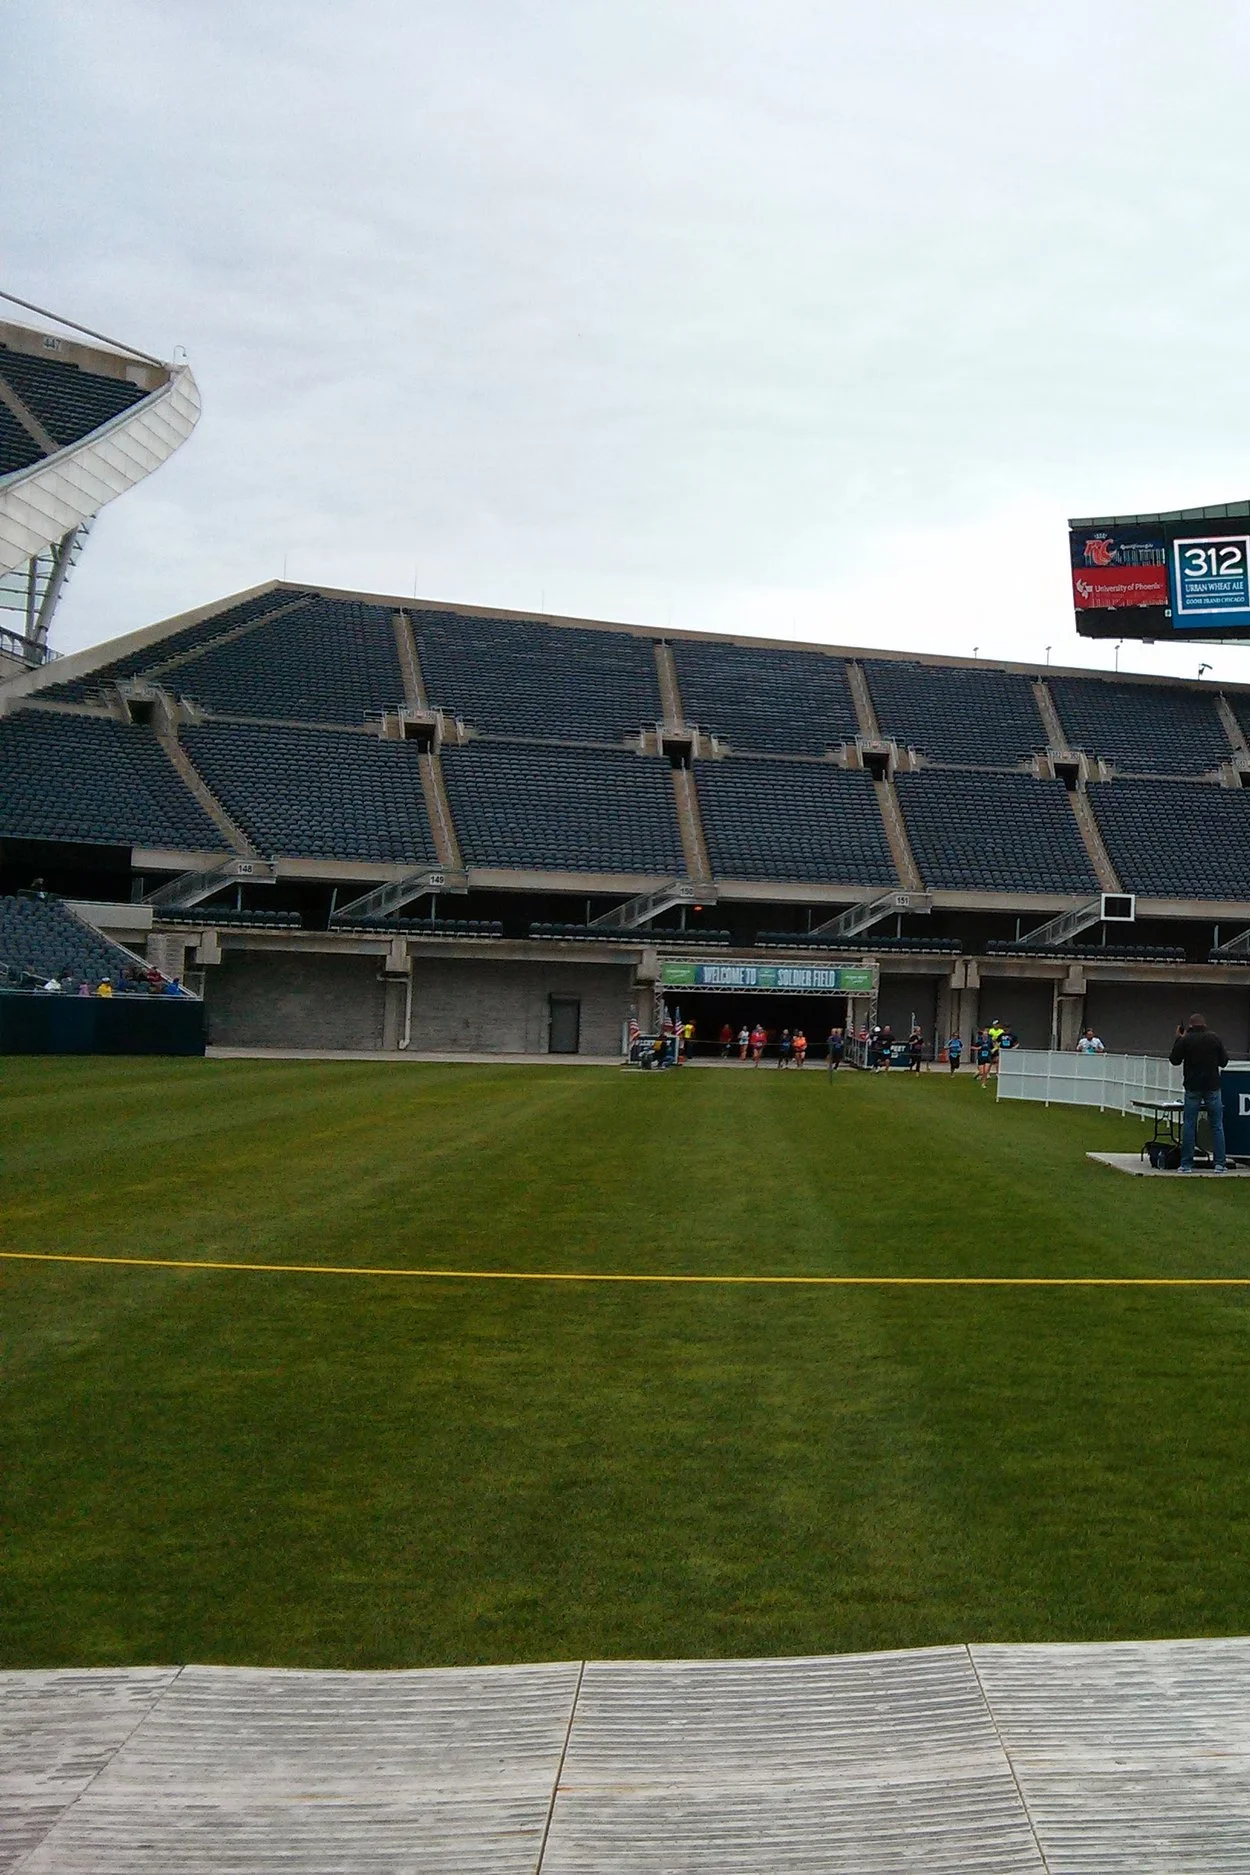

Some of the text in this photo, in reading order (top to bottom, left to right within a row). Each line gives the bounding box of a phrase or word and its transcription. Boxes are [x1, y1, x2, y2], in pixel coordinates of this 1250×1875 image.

[1184, 546, 1243, 576] 312
[1135, 582, 1160, 590] Phoenix
[1185, 581, 1244, 592] URBAN WHEAT ALE
[703, 966, 757, 985] WELCOME TO
[778, 969, 812, 987] SOLDIER
[812, 971, 836, 988] FIELD
